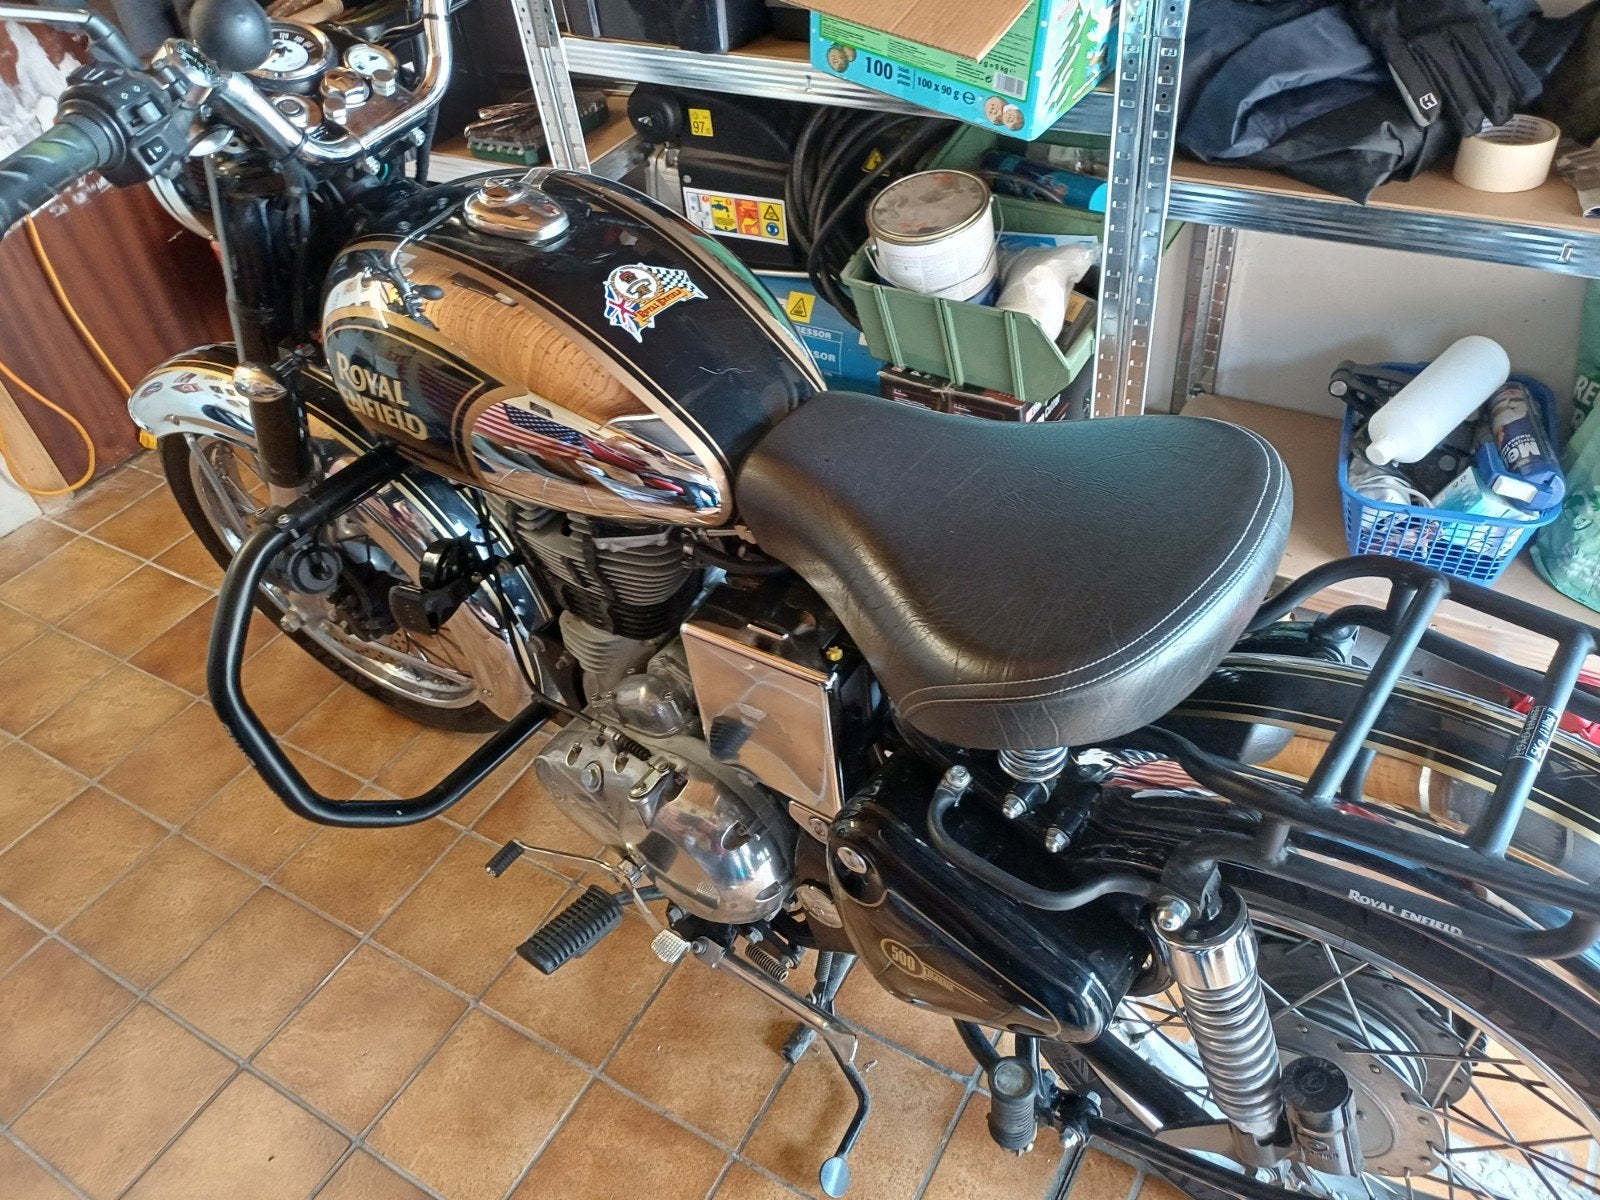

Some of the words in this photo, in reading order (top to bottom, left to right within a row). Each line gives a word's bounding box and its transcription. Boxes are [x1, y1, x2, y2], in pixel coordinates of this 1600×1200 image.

[866, 57, 893, 80] 100
[918, 77, 933, 90] 100
[941, 85, 952, 96] 90
[953, 90, 960, 101] g
[692, 120, 705, 134] 97
[797, 326, 832, 340] ESSOR
[336, 351, 410, 407] ROYAL
[340, 385, 429, 441] ENFIELD
[1348, 888, 1396, 914] ROYAL
[1400, 908, 1463, 937] ENFIELD
[891, 945, 916, 972] 500
